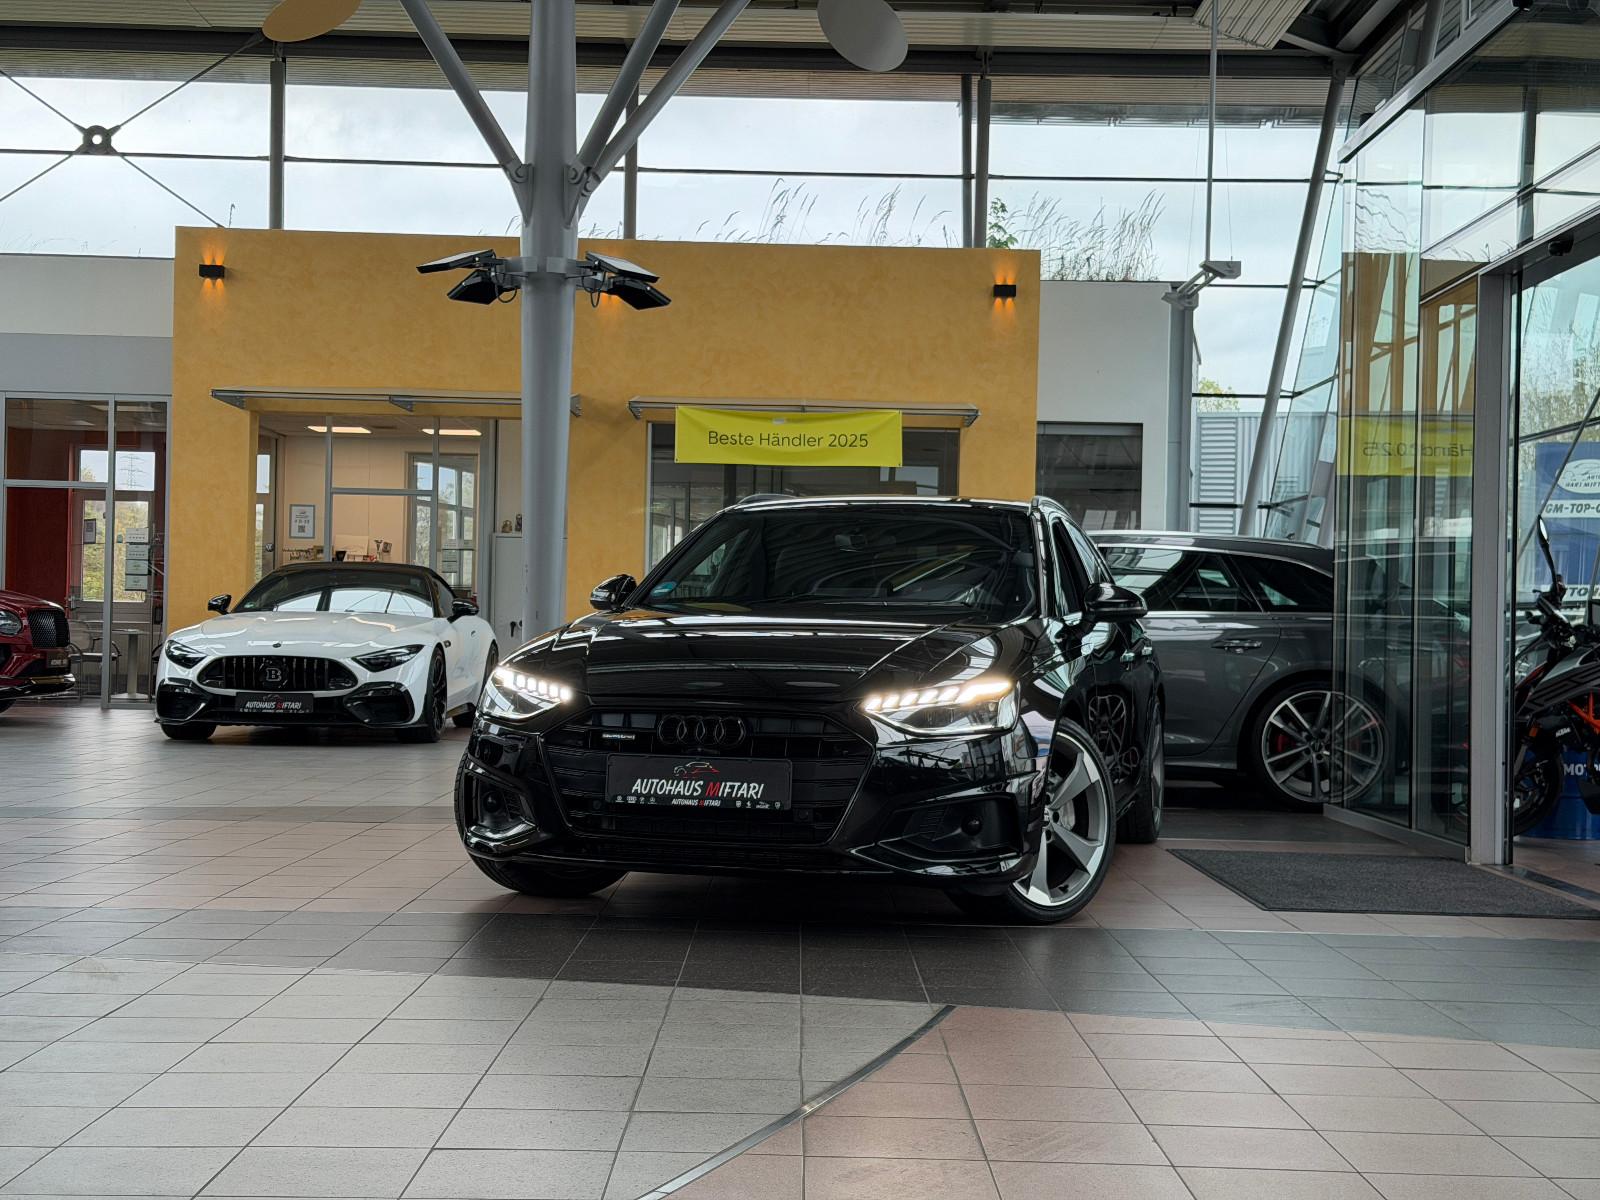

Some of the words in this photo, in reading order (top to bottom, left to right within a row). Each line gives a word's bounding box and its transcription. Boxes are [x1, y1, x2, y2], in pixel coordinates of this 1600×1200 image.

[708, 430, 754, 446] Beste
[759, 432, 824, 448] Händler
[828, 433, 869, 448] 2025
[245, 701, 277, 709] AUTOHAUS
[631, 778, 704, 797] AUTOHAUS
[705, 781, 764, 800] MIFTARI
[671, 798, 699, 806] AUTOHAUS
